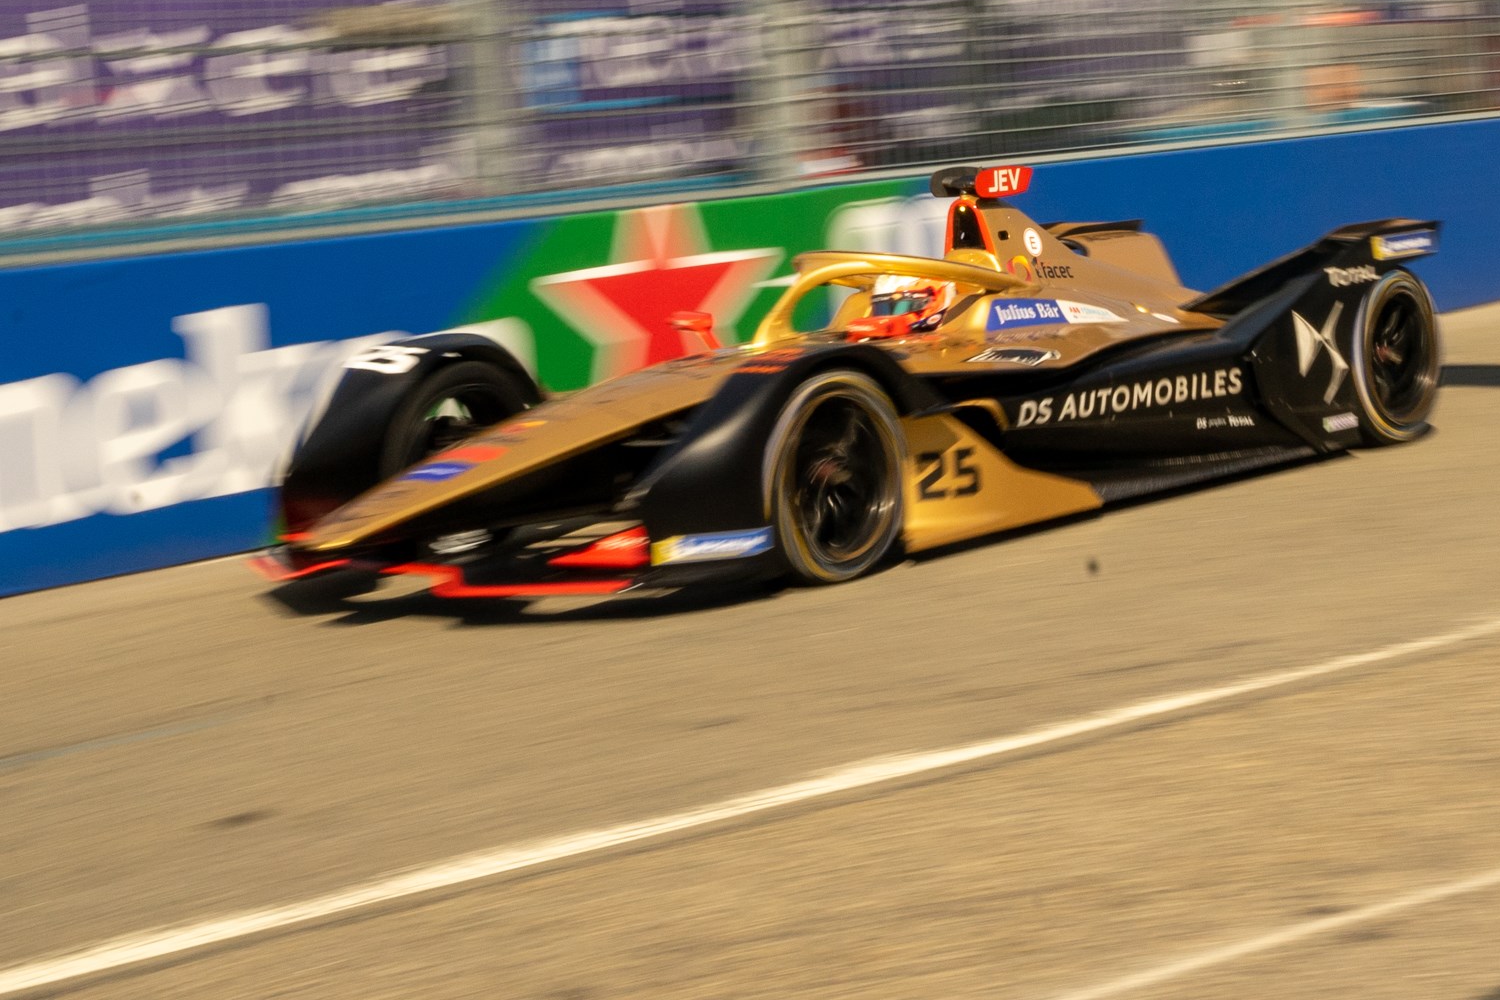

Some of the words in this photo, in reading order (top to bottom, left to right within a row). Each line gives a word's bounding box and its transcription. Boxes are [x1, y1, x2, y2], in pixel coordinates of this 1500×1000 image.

[988, 167, 1021, 193] JEV
[994, 303, 1036, 325] Julius
[1036, 302, 1060, 319] Bär
[1016, 397, 1053, 427] DS
[1058, 367, 1243, 422] AUTOMOBILES
[914, 447, 983, 500] 25
